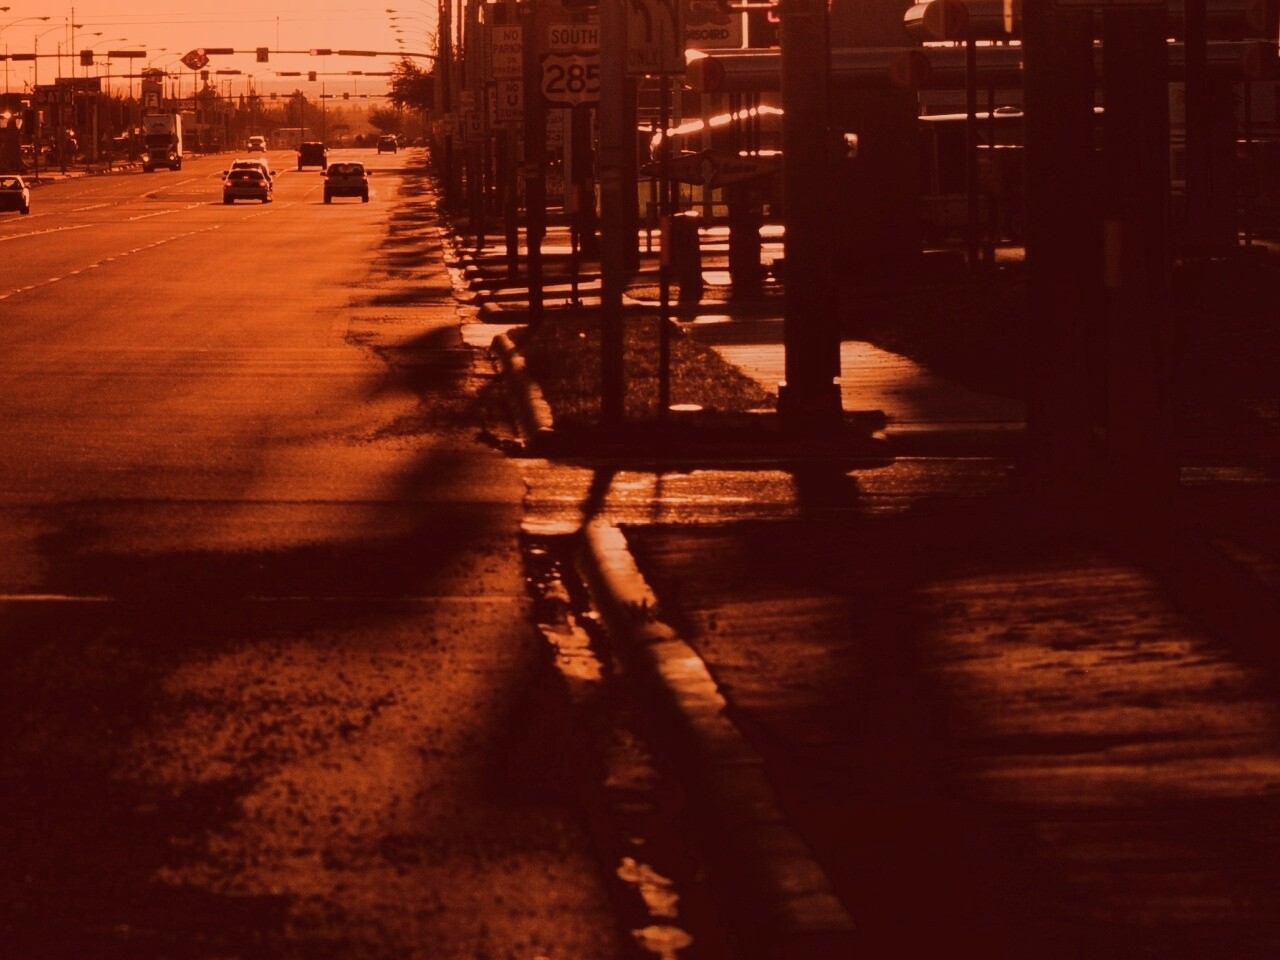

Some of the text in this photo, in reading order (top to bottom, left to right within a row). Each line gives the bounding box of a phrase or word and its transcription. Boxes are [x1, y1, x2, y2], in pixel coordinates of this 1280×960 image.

[503, 31, 519, 41] NO
[551, 29, 598, 44] SOUTH
[545, 64, 601, 93] 285
[507, 95, 518, 107] U
